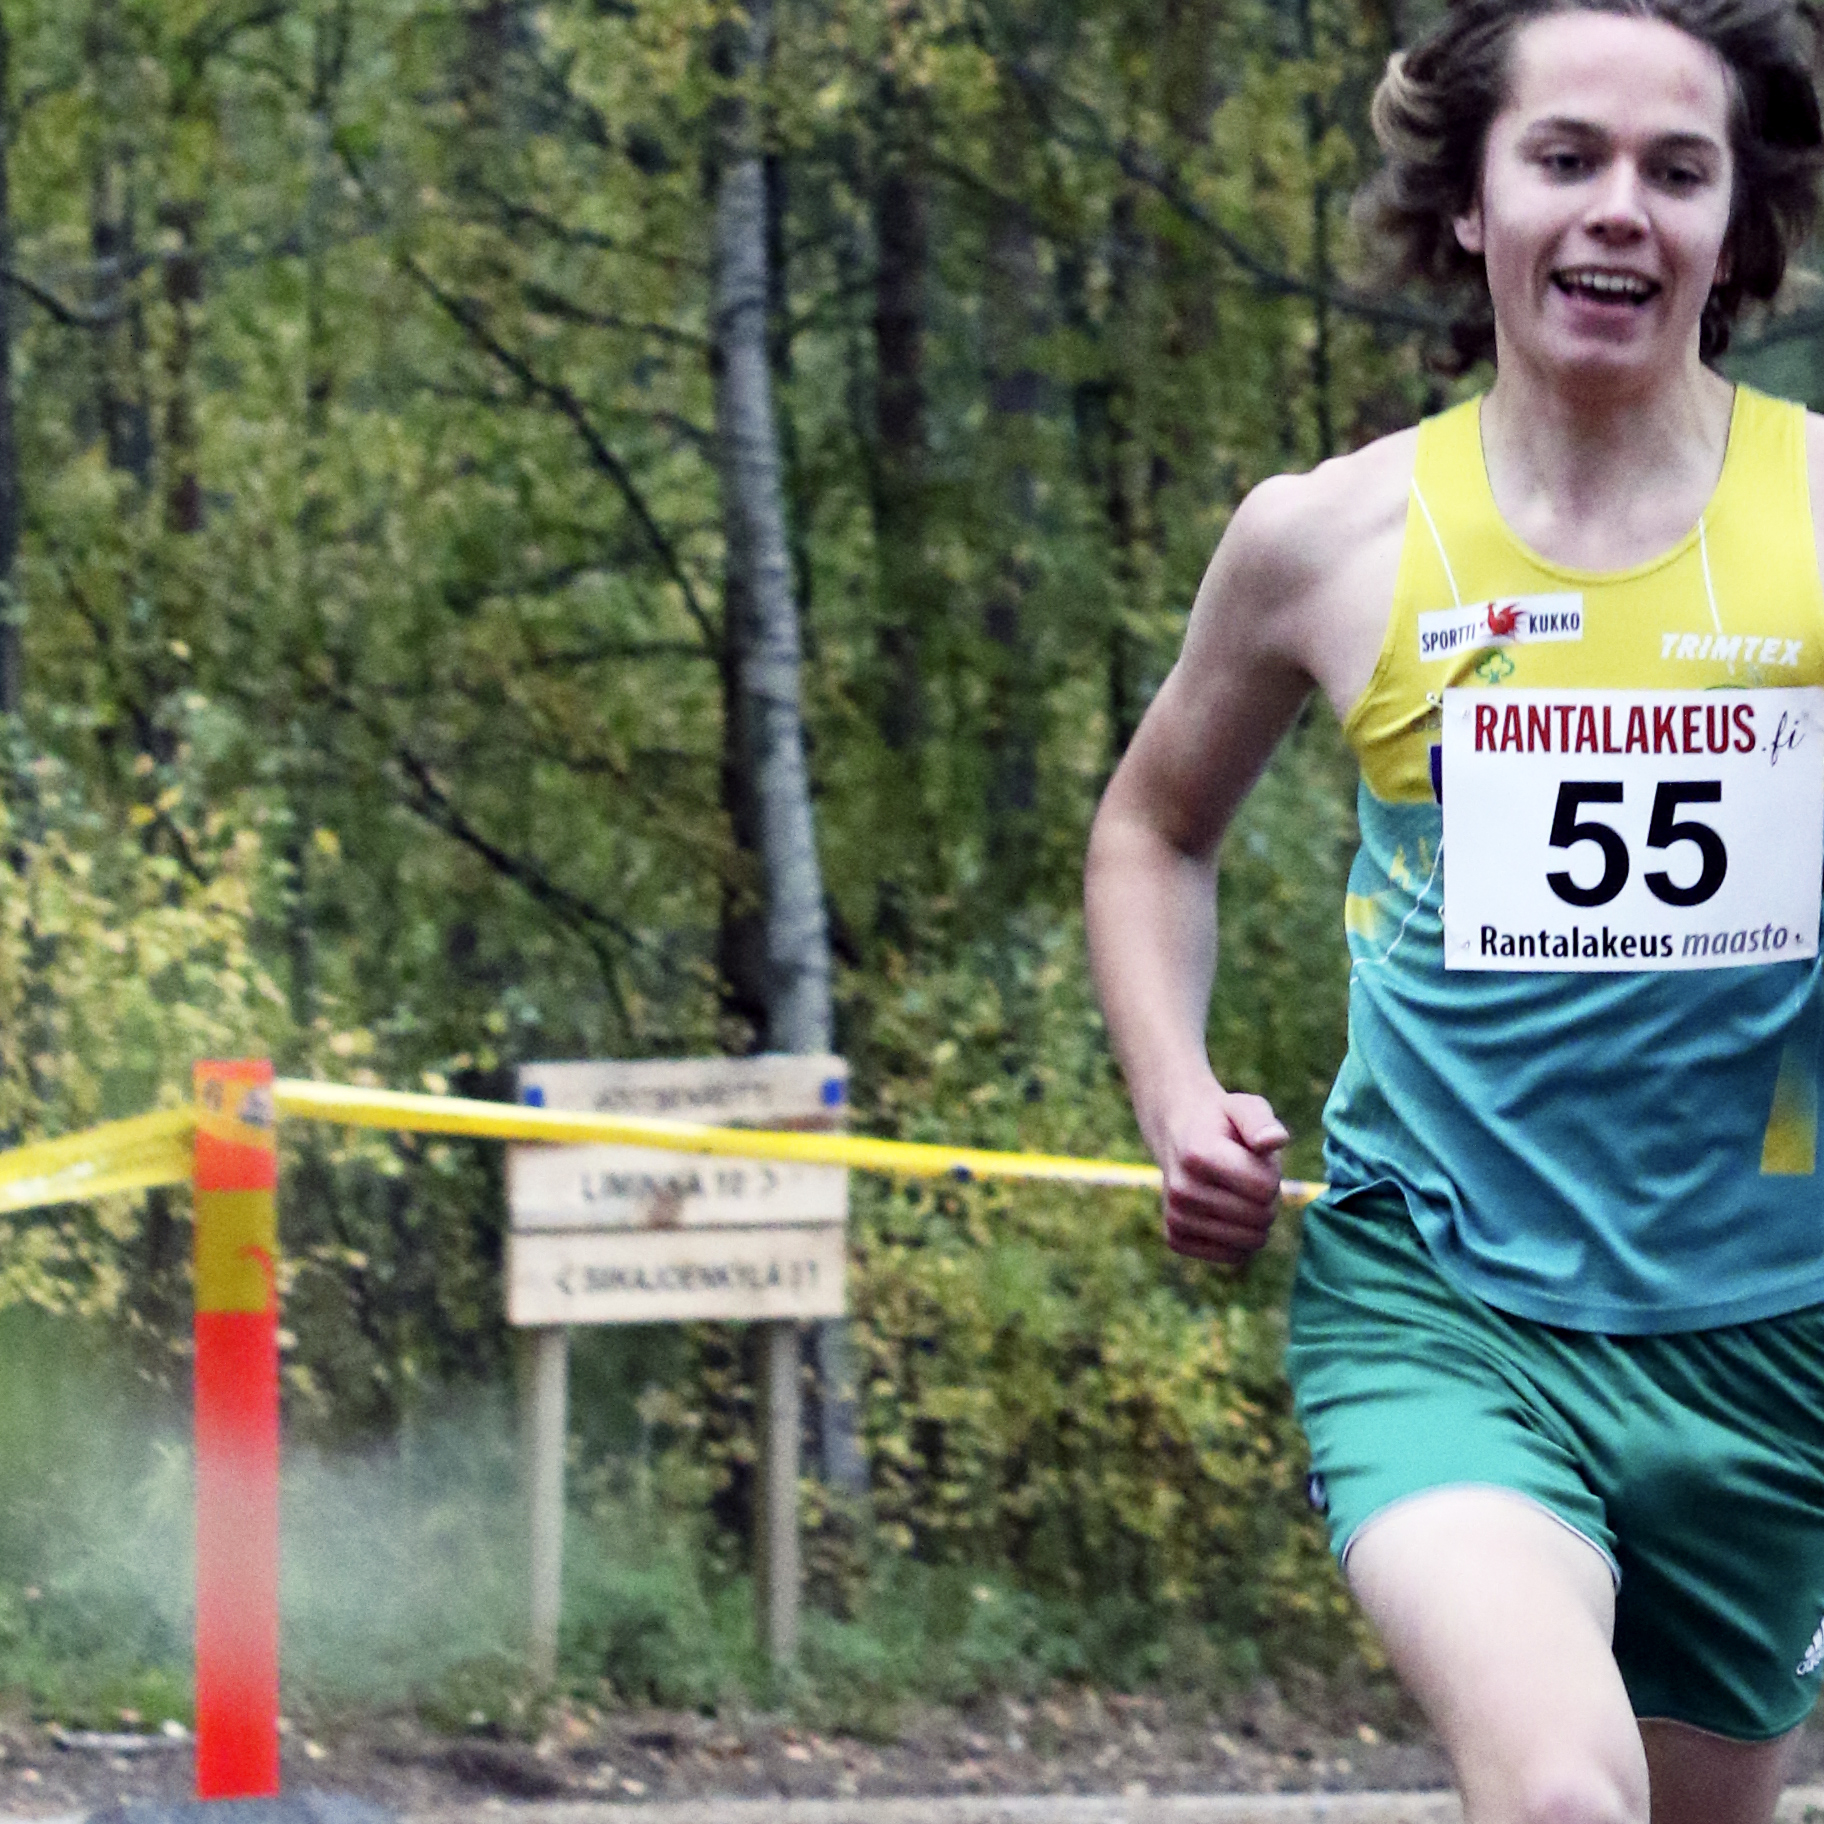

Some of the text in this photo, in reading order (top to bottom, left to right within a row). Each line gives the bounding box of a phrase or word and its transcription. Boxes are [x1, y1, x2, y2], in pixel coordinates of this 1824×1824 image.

[1421, 611, 1580, 654] SPORTTI KUKKO
[1659, 632, 1803, 667] TRIMTEX
[1546, 780, 1728, 908] 55
[1480, 924, 1788, 958] Rantalakeus maasto
